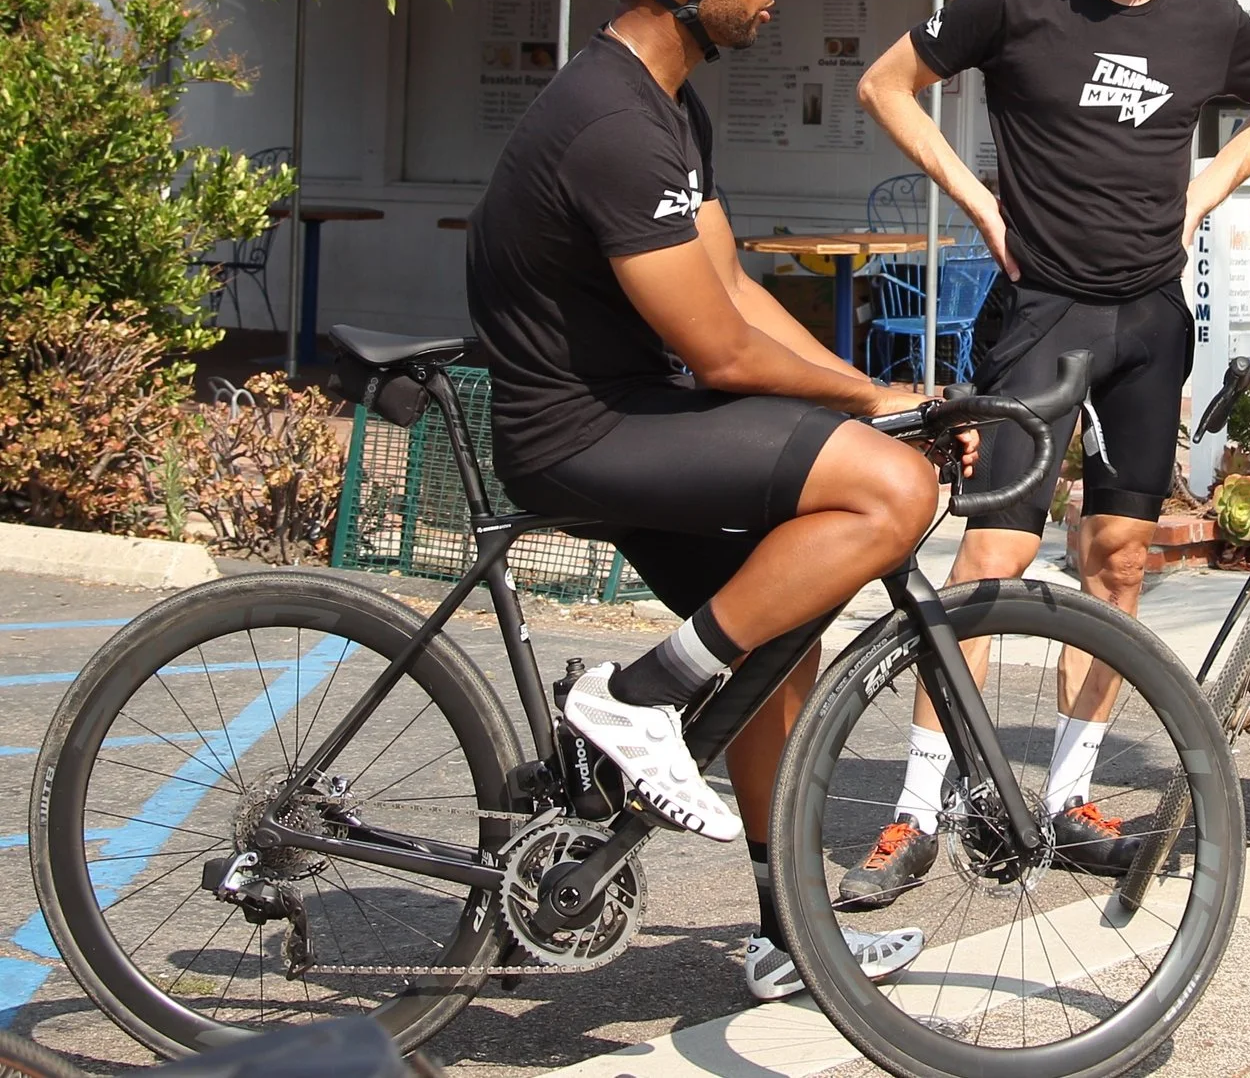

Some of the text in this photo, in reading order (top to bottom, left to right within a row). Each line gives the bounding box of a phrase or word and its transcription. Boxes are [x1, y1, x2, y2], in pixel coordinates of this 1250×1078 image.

[1195, 214, 1211, 342] ELCOME
[848, 638, 888, 677] exposure
[863, 635, 920, 691] ZIPP
[575, 737, 592, 792] wahoo
[910, 748, 947, 761] GIRO
[635, 777, 706, 833] GIRO
